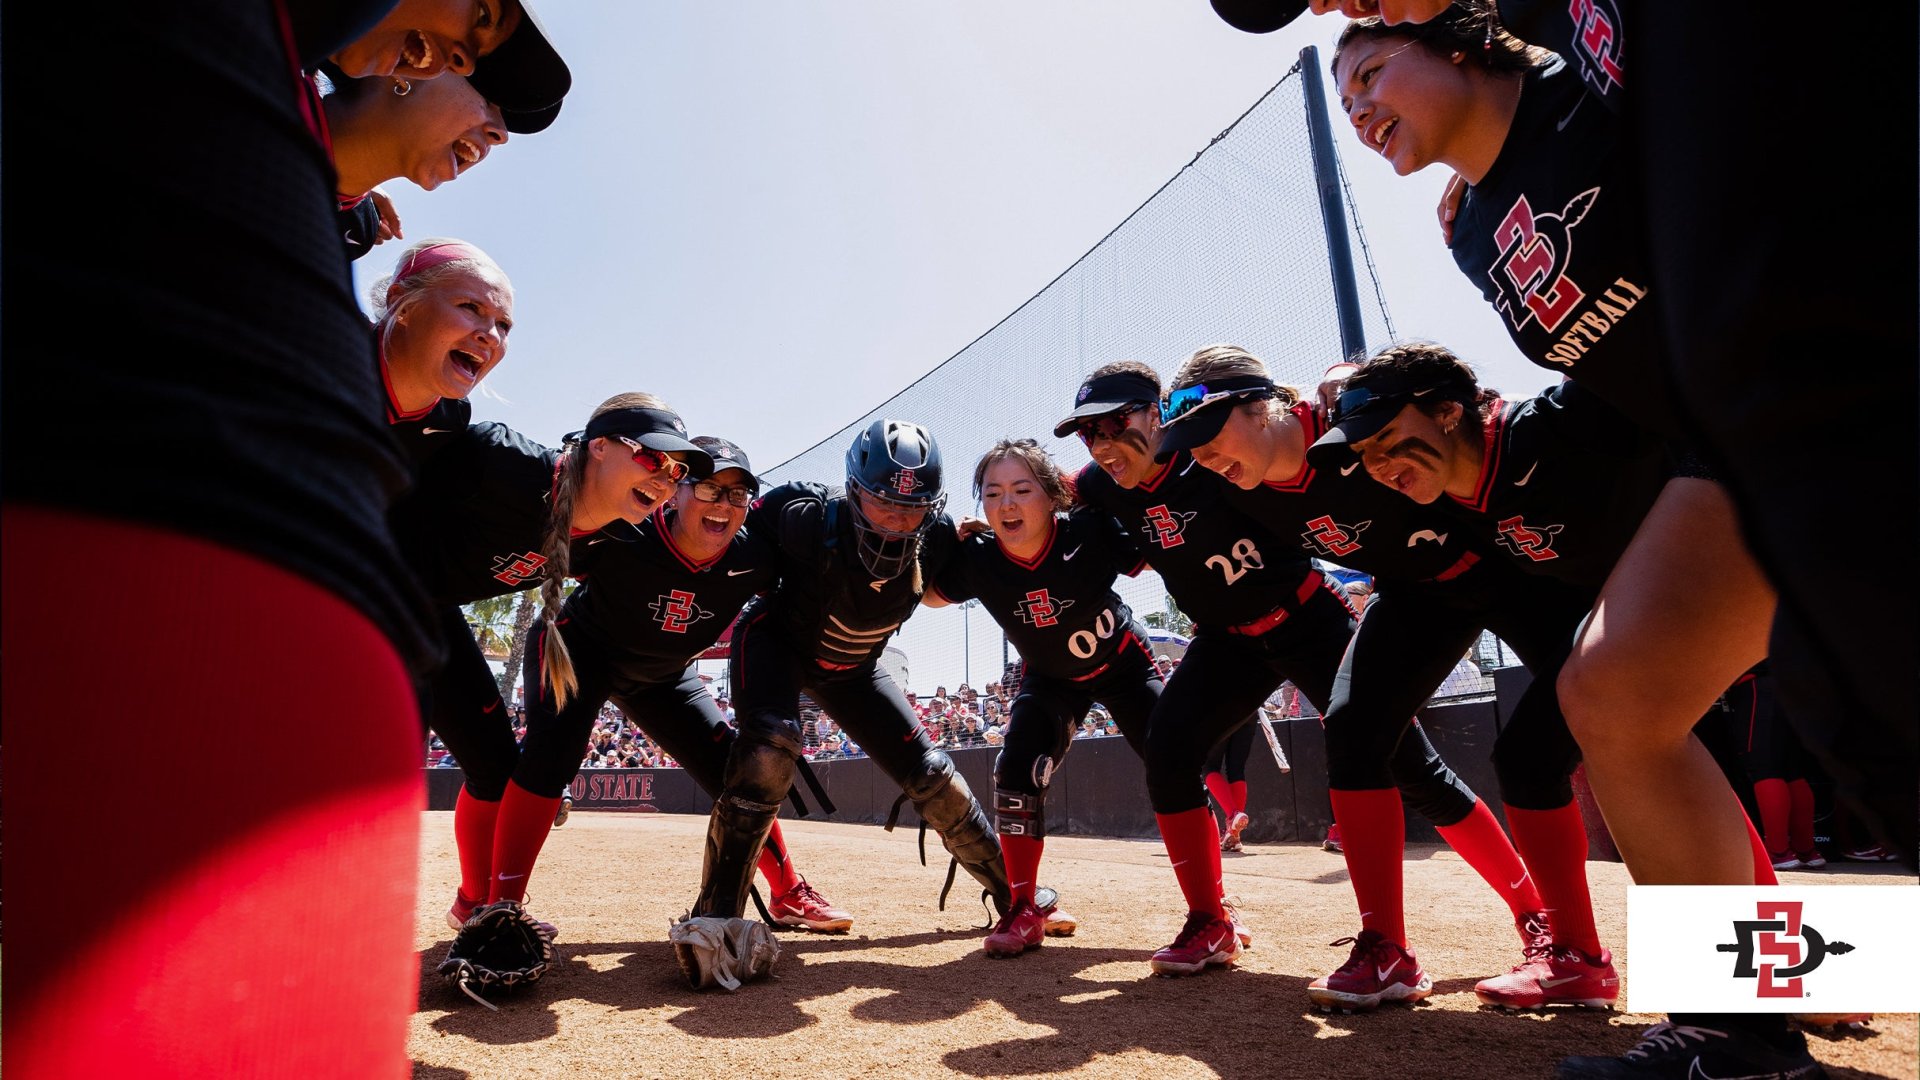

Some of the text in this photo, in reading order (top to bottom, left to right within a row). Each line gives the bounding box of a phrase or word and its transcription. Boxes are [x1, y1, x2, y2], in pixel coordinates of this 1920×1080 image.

[1545, 277, 1648, 367] SOFTBALL
[1204, 538, 1264, 586] 28
[589, 774, 653, 800] STATE
